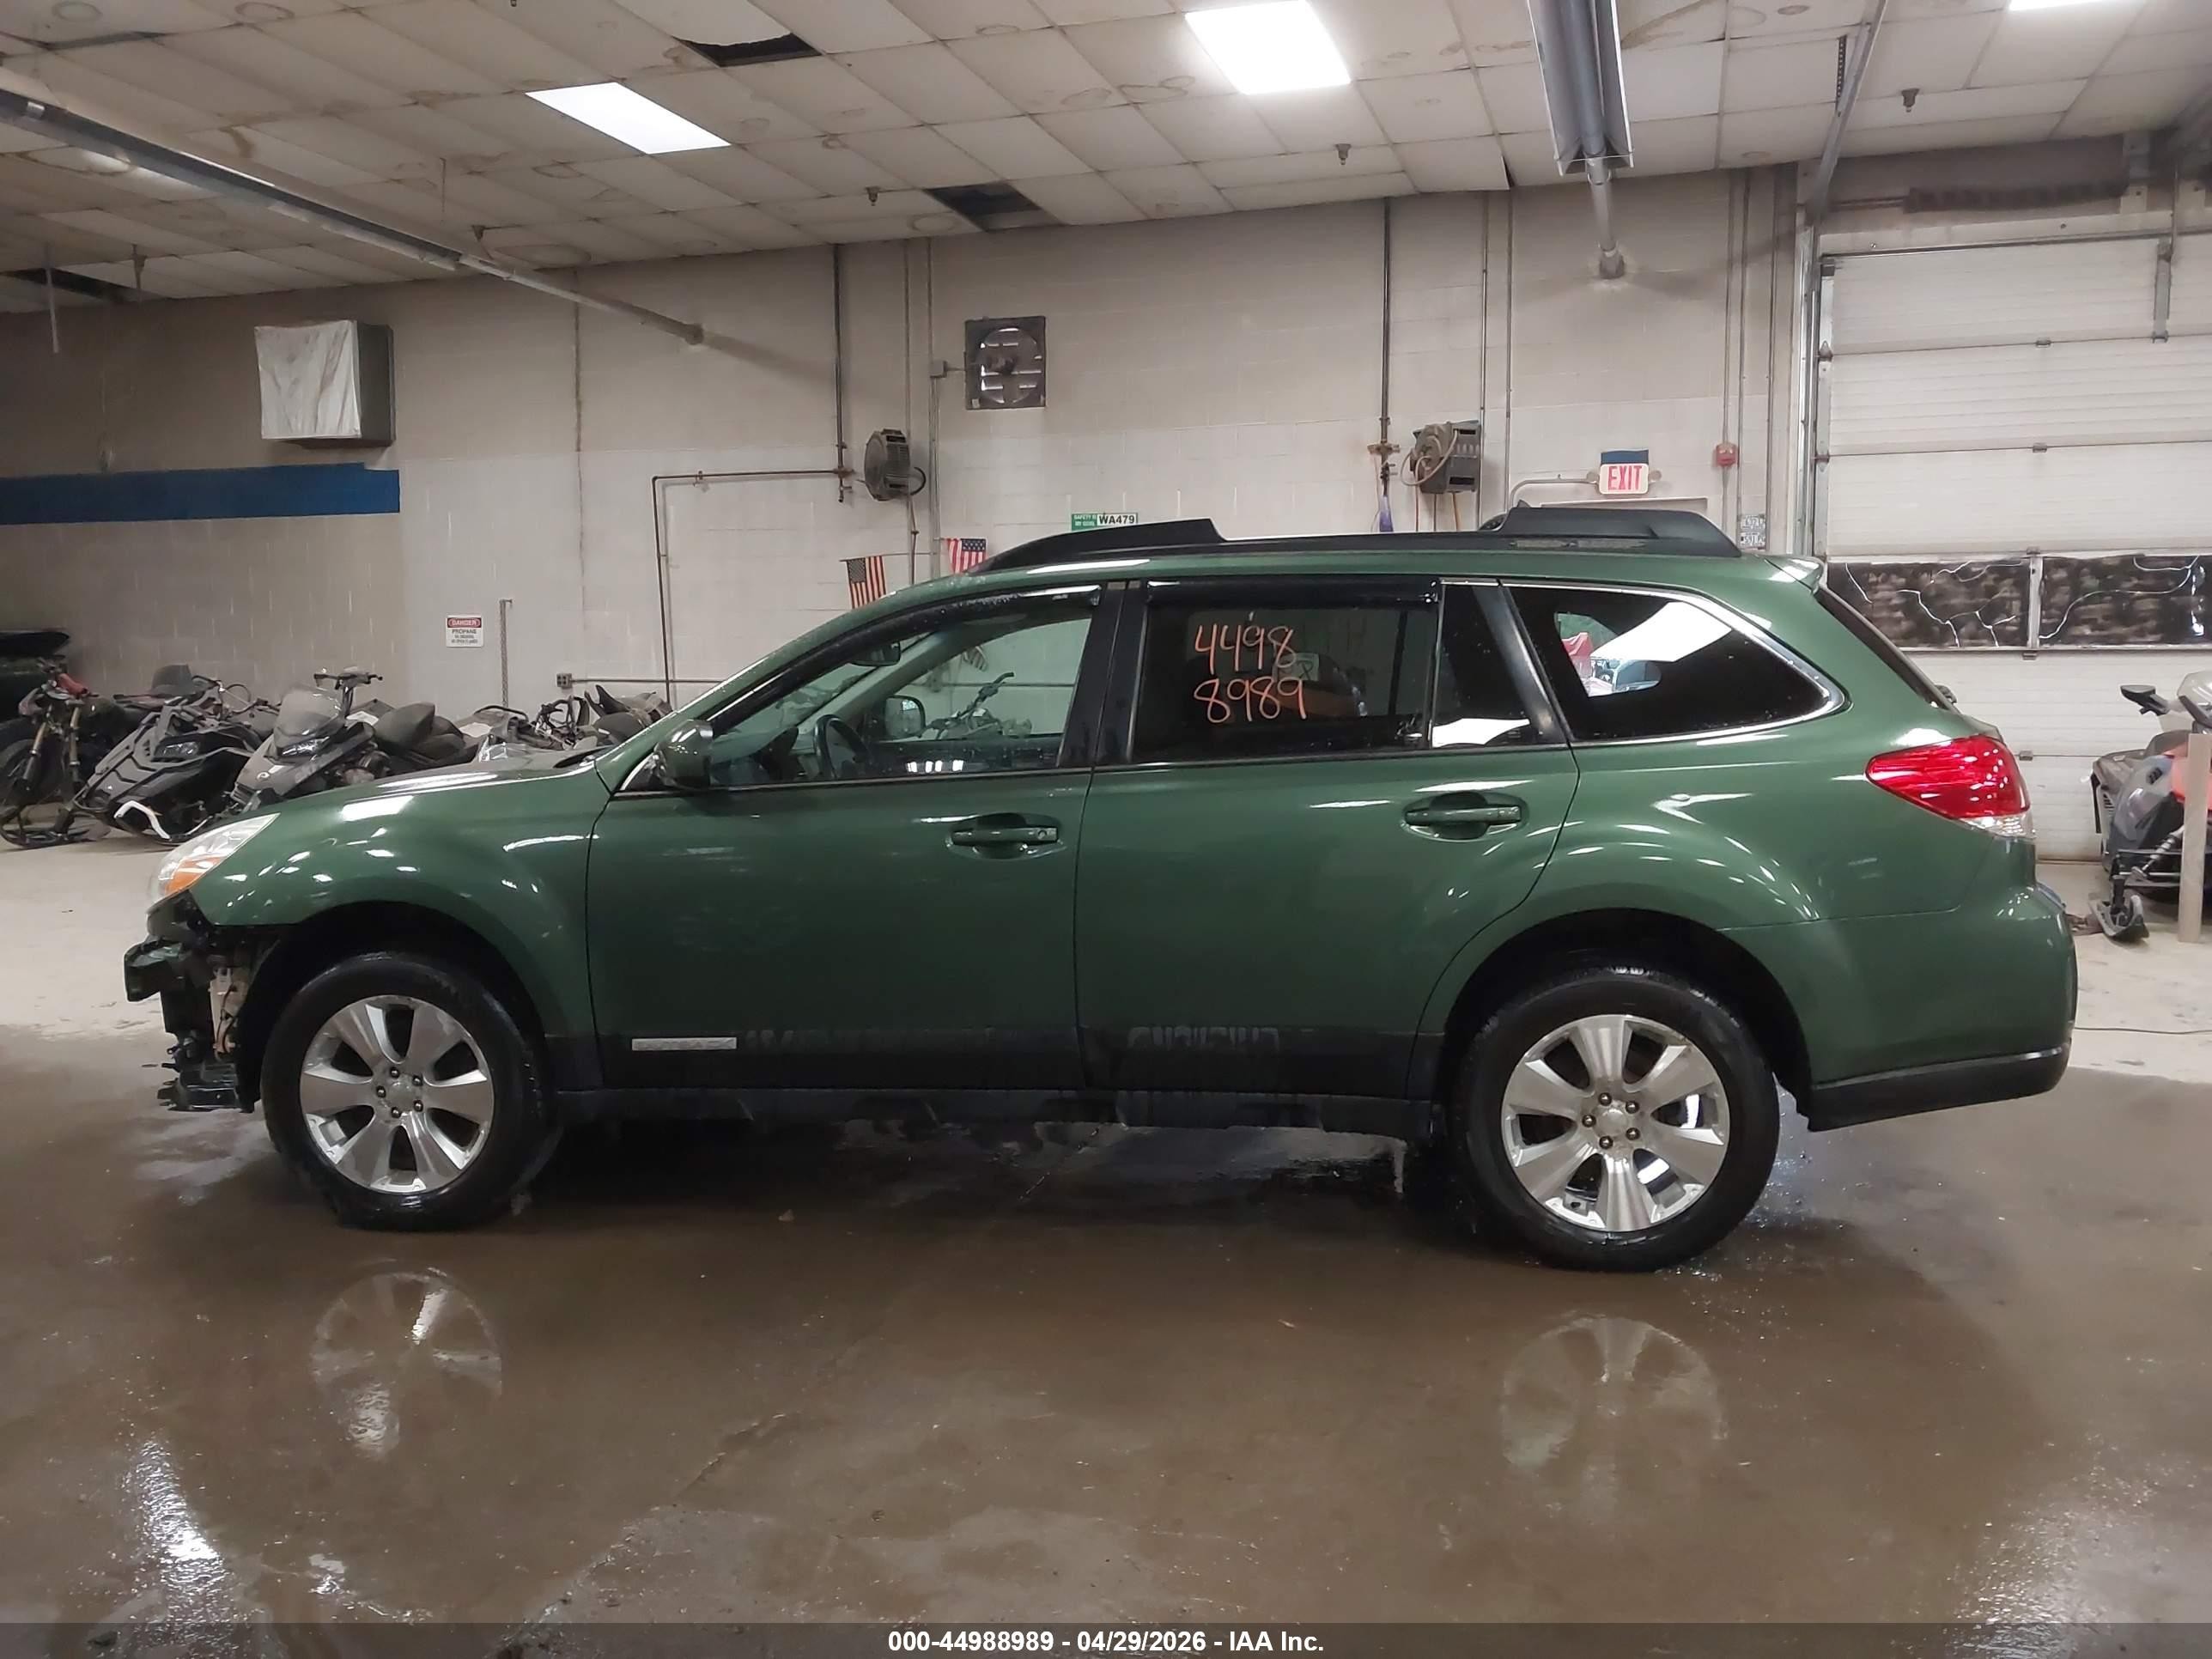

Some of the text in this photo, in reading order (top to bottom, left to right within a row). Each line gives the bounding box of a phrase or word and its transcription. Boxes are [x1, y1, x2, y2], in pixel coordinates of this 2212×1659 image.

[1607, 465, 1642, 489] EXIT
[1099, 514, 1135, 525] WA479
[1194, 623, 1297, 675] 4498
[1194, 676, 1307, 723] 8989
